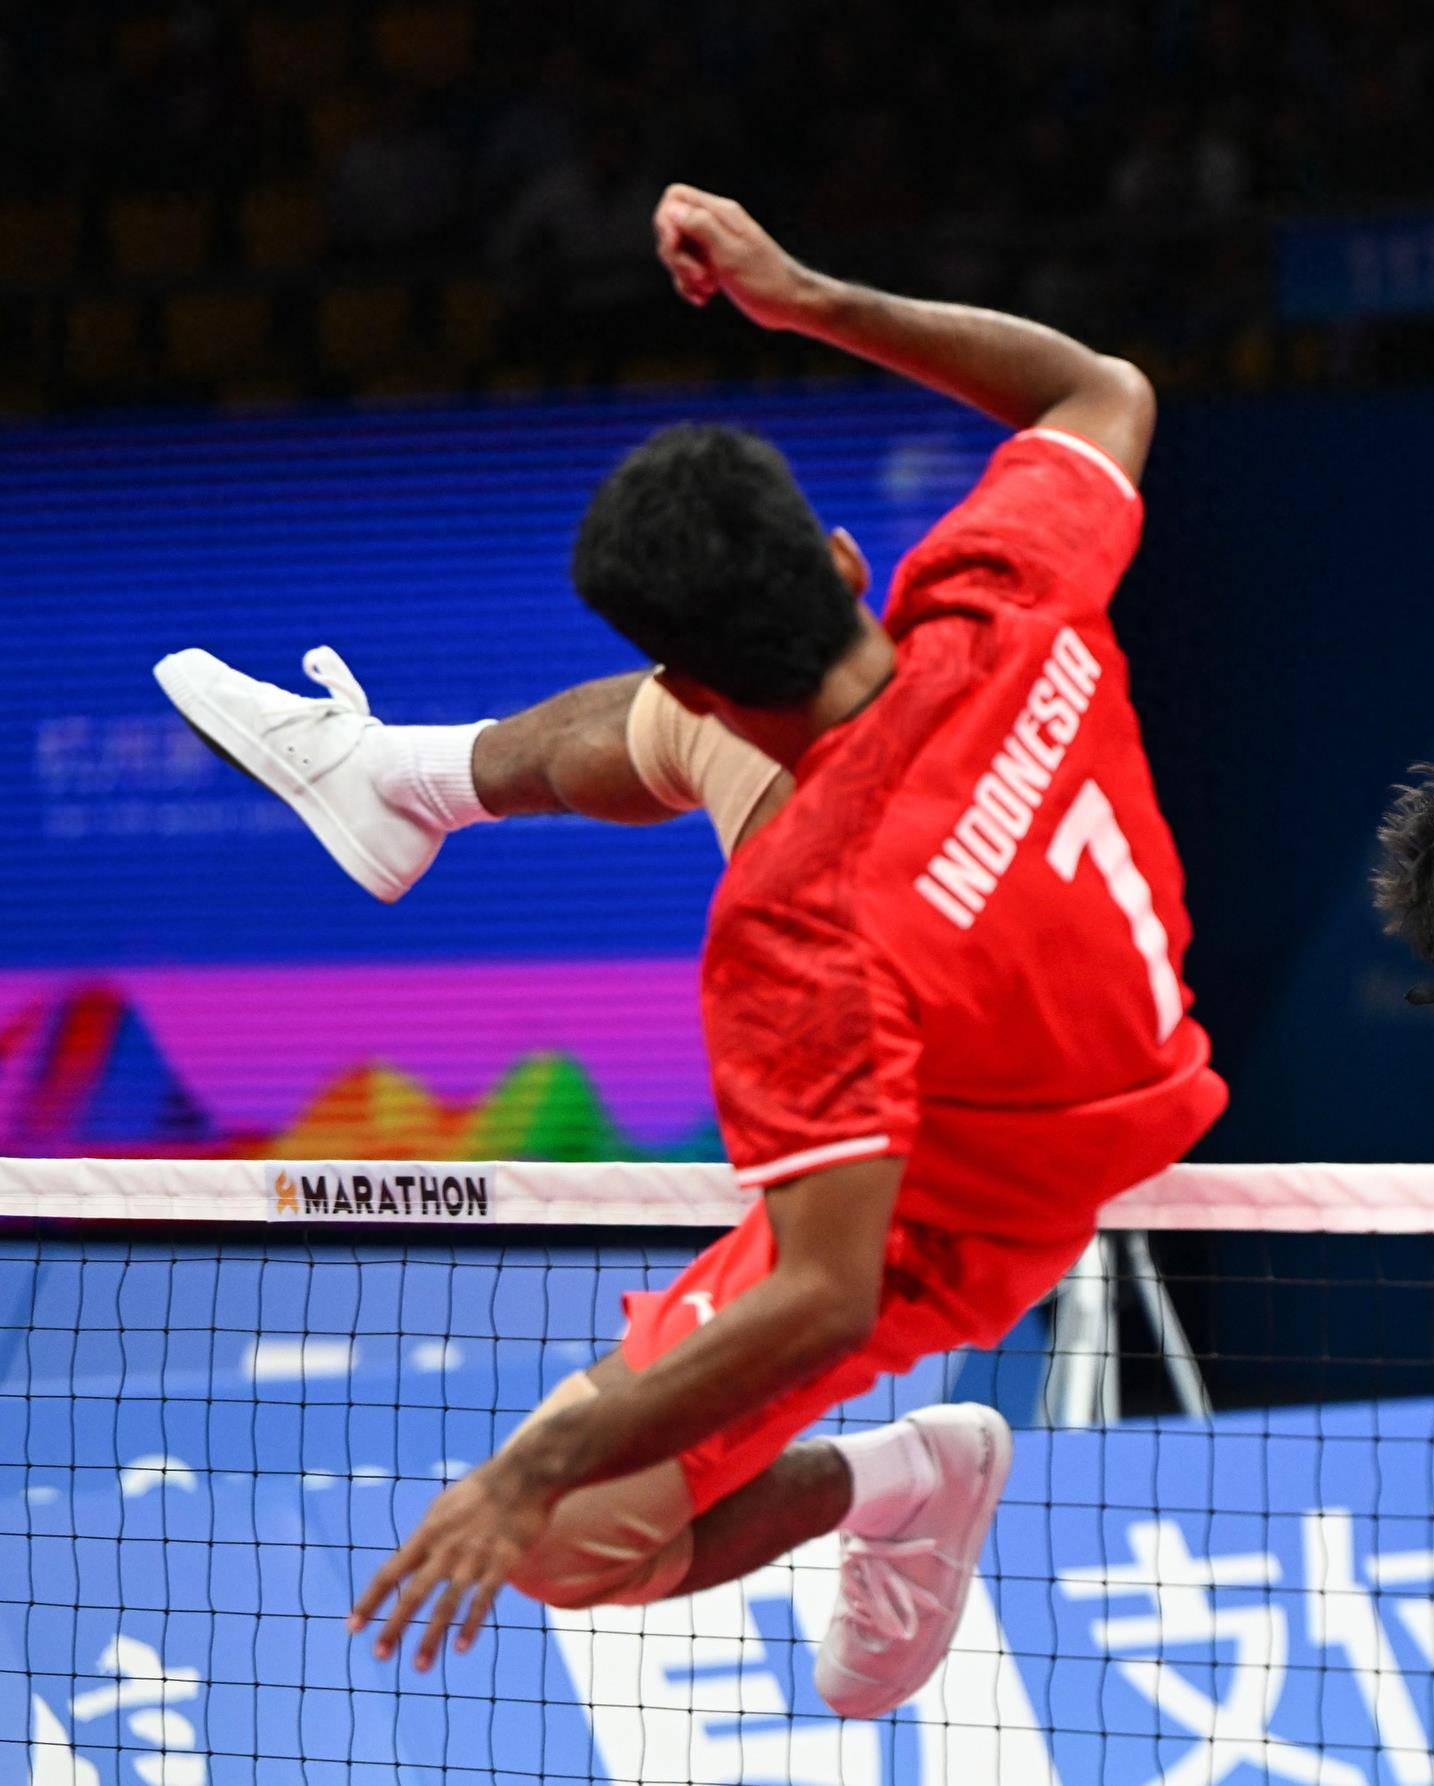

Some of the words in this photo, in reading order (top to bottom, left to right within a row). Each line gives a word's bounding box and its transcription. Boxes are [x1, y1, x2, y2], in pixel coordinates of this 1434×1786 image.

[914, 627, 1101, 930] INDONESIA
[1046, 779, 1184, 1046] 7
[301, 1175, 488, 1217] MARATHON
